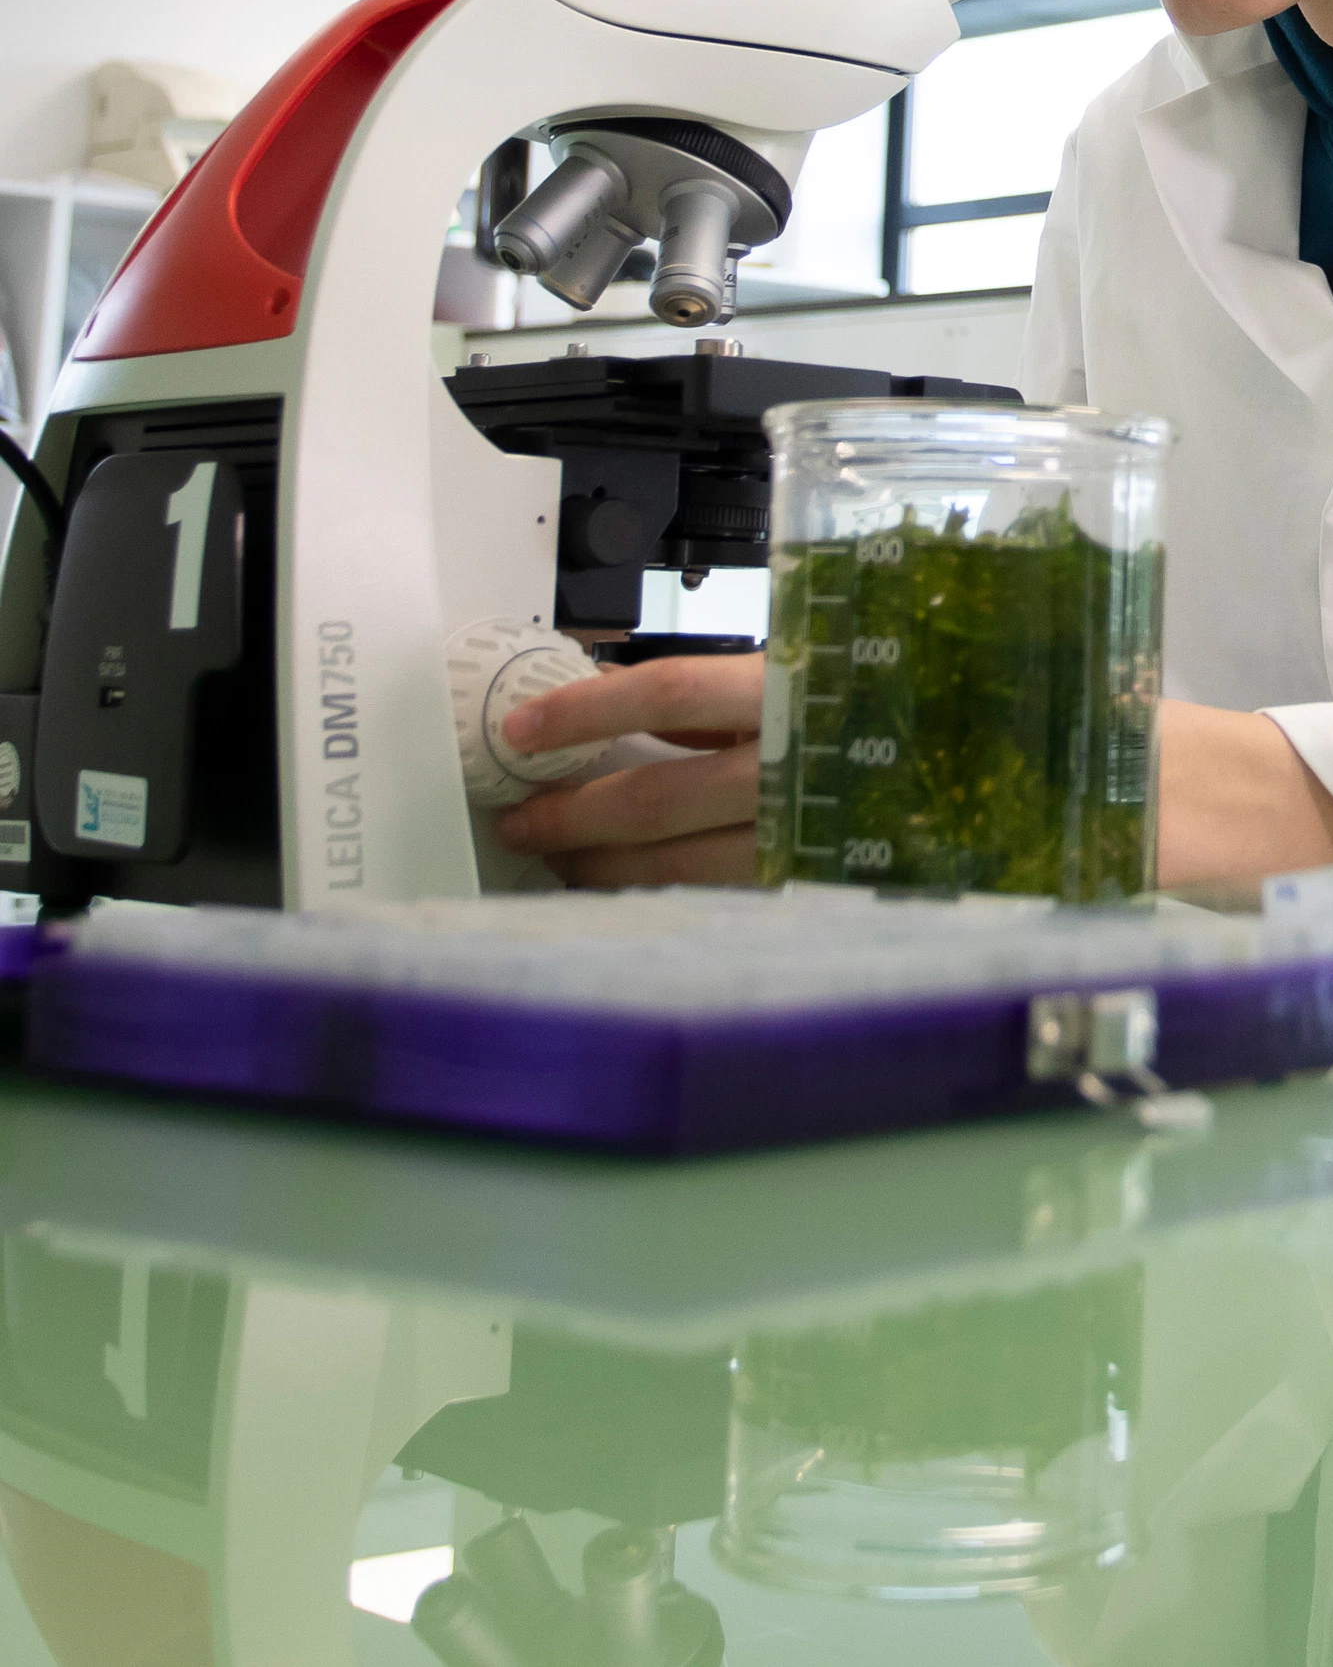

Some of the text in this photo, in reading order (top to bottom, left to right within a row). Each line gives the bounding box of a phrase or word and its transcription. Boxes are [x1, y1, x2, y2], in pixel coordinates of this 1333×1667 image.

[165, 461, 218, 630] 1
[852, 635, 900, 666] 600
[318, 620, 364, 891] LEICA DM750
[847, 736, 897, 766] 400
[842, 837, 892, 868] 200
